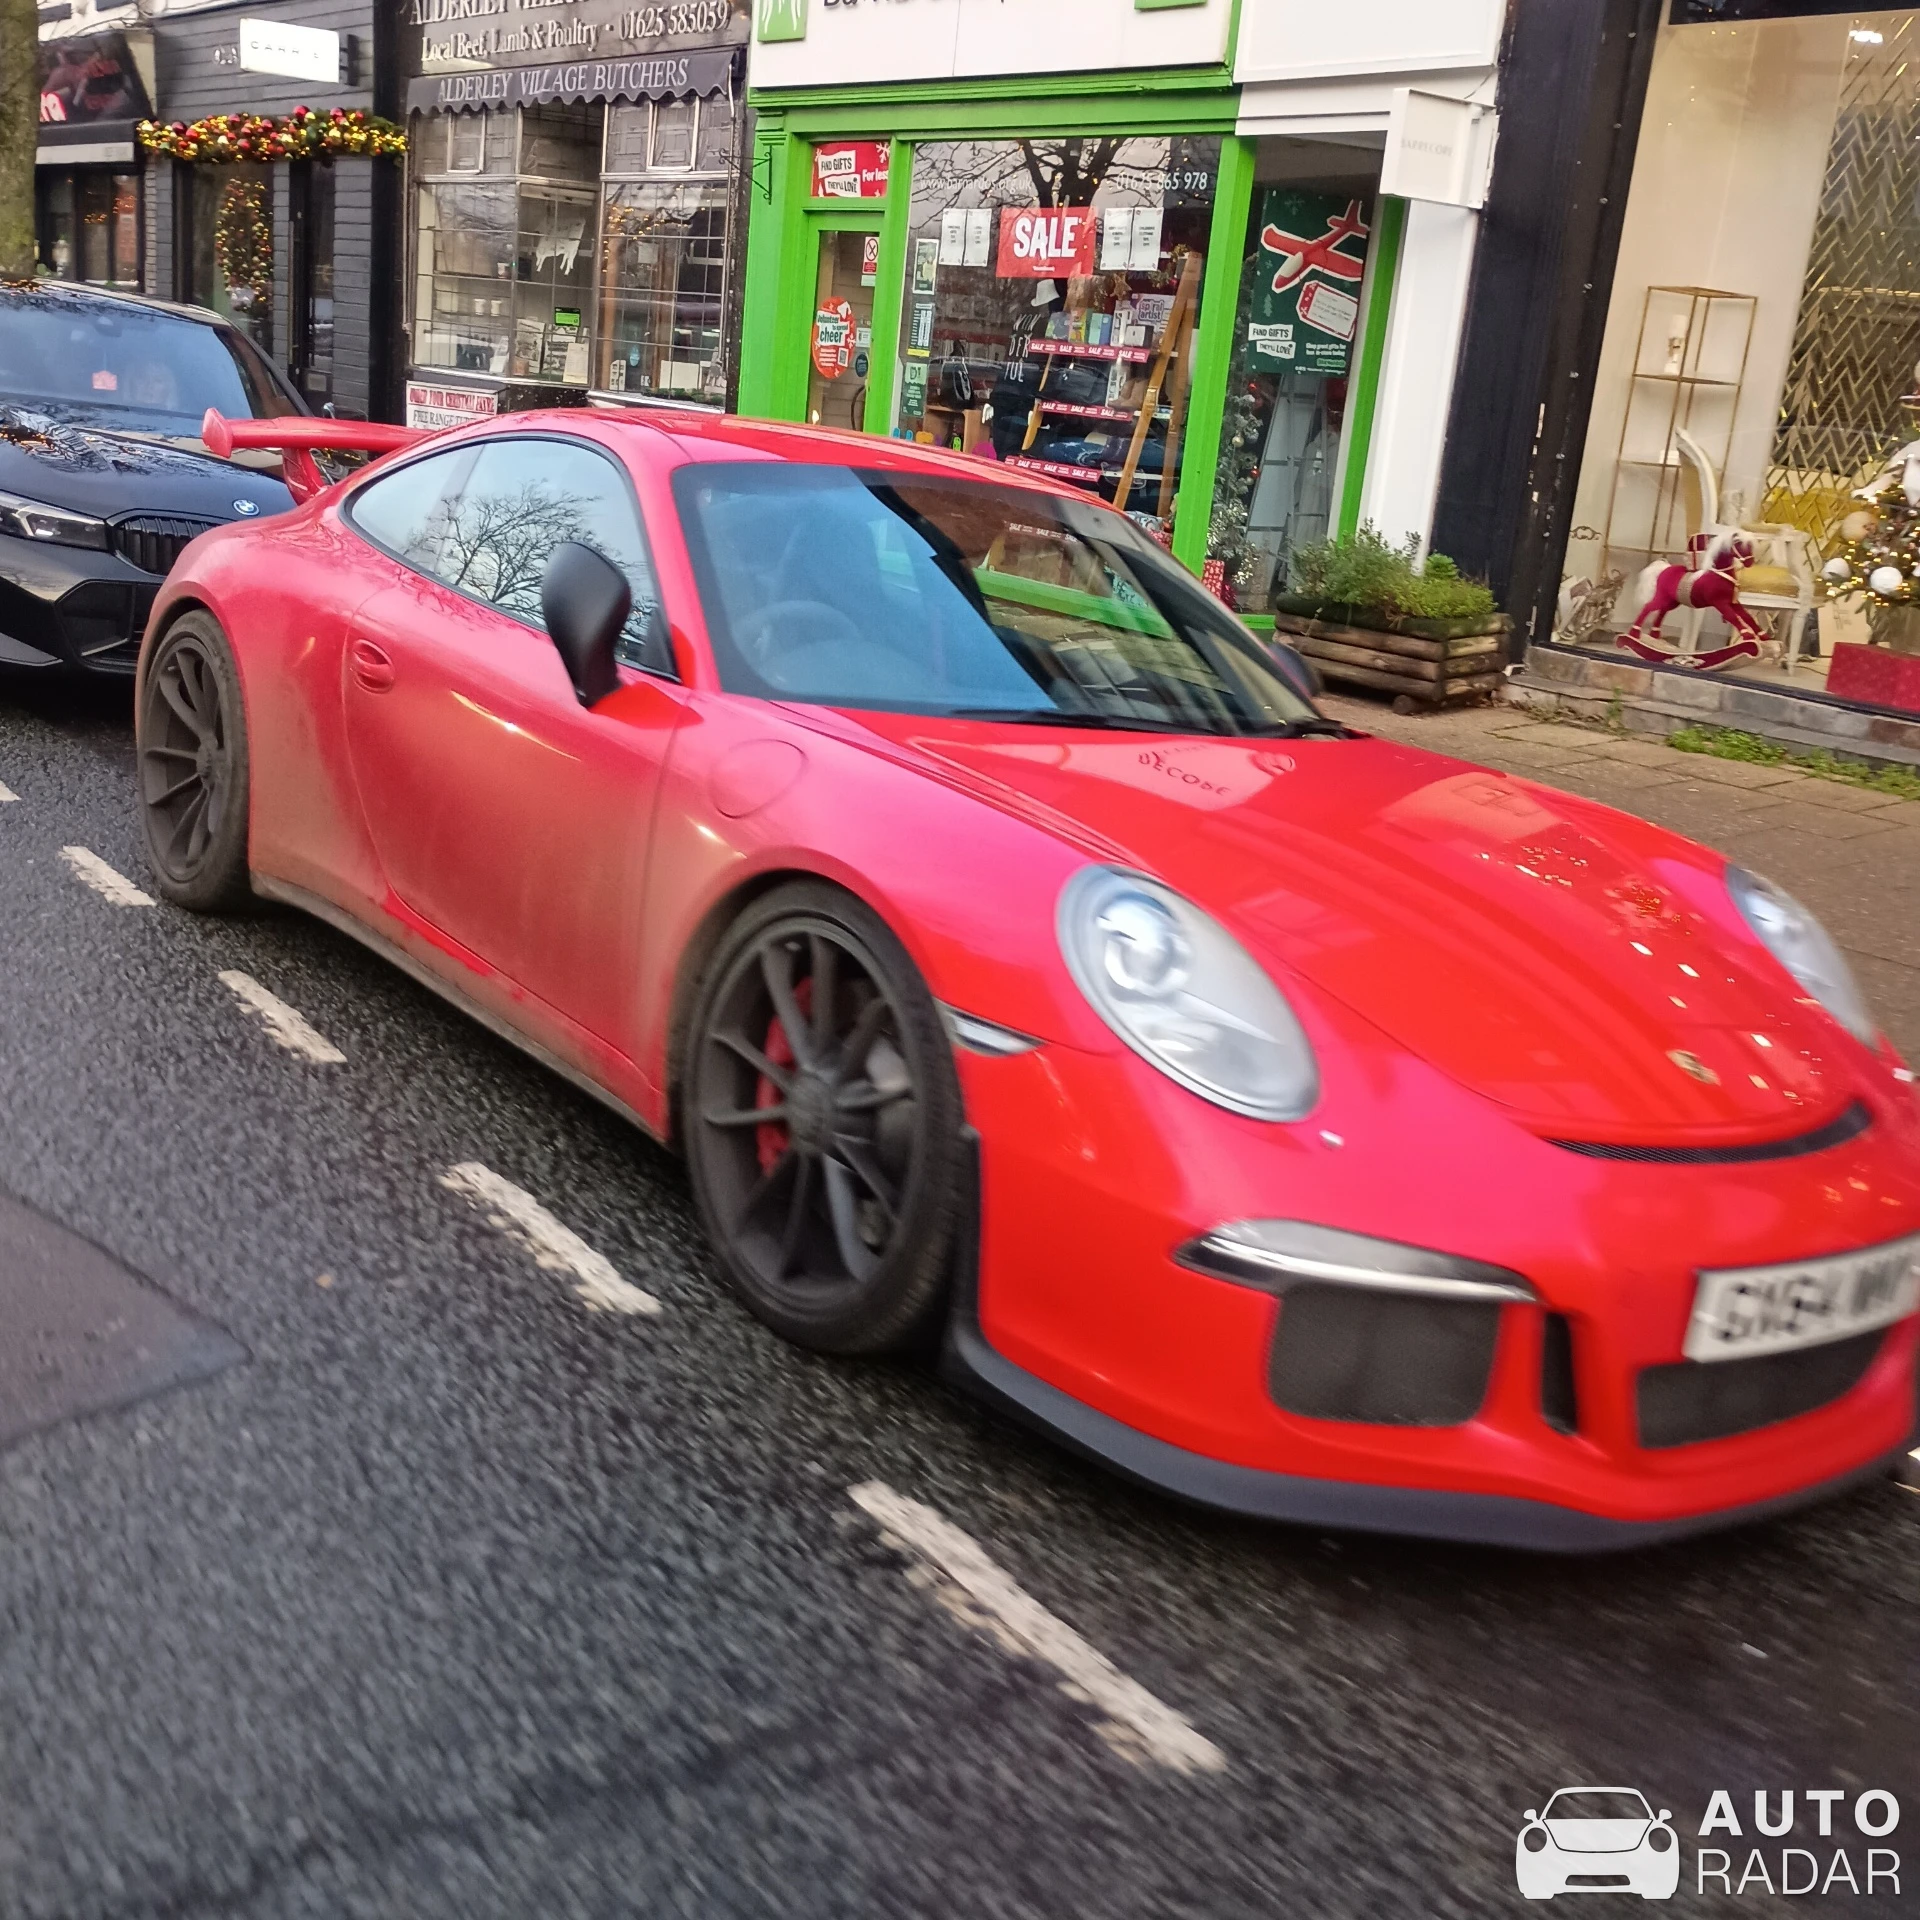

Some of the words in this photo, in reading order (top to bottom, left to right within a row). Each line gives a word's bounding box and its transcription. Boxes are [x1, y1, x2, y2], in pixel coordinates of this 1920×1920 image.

[421, 34, 454, 62] Local
[490, 25, 527, 53] Lamb
[531, 22, 546, 49] &
[547, 17, 598, 52] Poultry
[619, 7, 666, 40] 01625
[668, 0, 732, 35] 585059
[438, 73, 513, 103] ALDERLEY
[519, 65, 588, 94] VILLAGE
[592, 58, 689, 91] BUTCHERS
[833, 157, 852, 170] GIFTS
[862, 169, 875, 182] For
[1184, 171, 1208, 190] 978
[844, 180, 857, 193] LOVE
[1014, 216, 1079, 258] SALE
[1140, 311, 1161, 320] artist
[820, 327, 842, 343] cheer
[1269, 328, 1289, 338] GIFTS
[1031, 343, 1045, 351] SALE
[1059, 345, 1073, 353] SALE
[1088, 347, 1102, 355] SALE
[1118, 350, 1133, 359] SALE
[1042, 402, 1056, 410] SALE
[1070, 405, 1084, 413] SALE
[1101, 408, 1115, 417] SALE
[414, 410, 428, 423] FREE
[430, 412, 454, 426] RANGE
[1017, 460, 1031, 468] SALE
[1044, 464, 1058, 472] SALE
[1072, 469, 1086, 478] SALE
